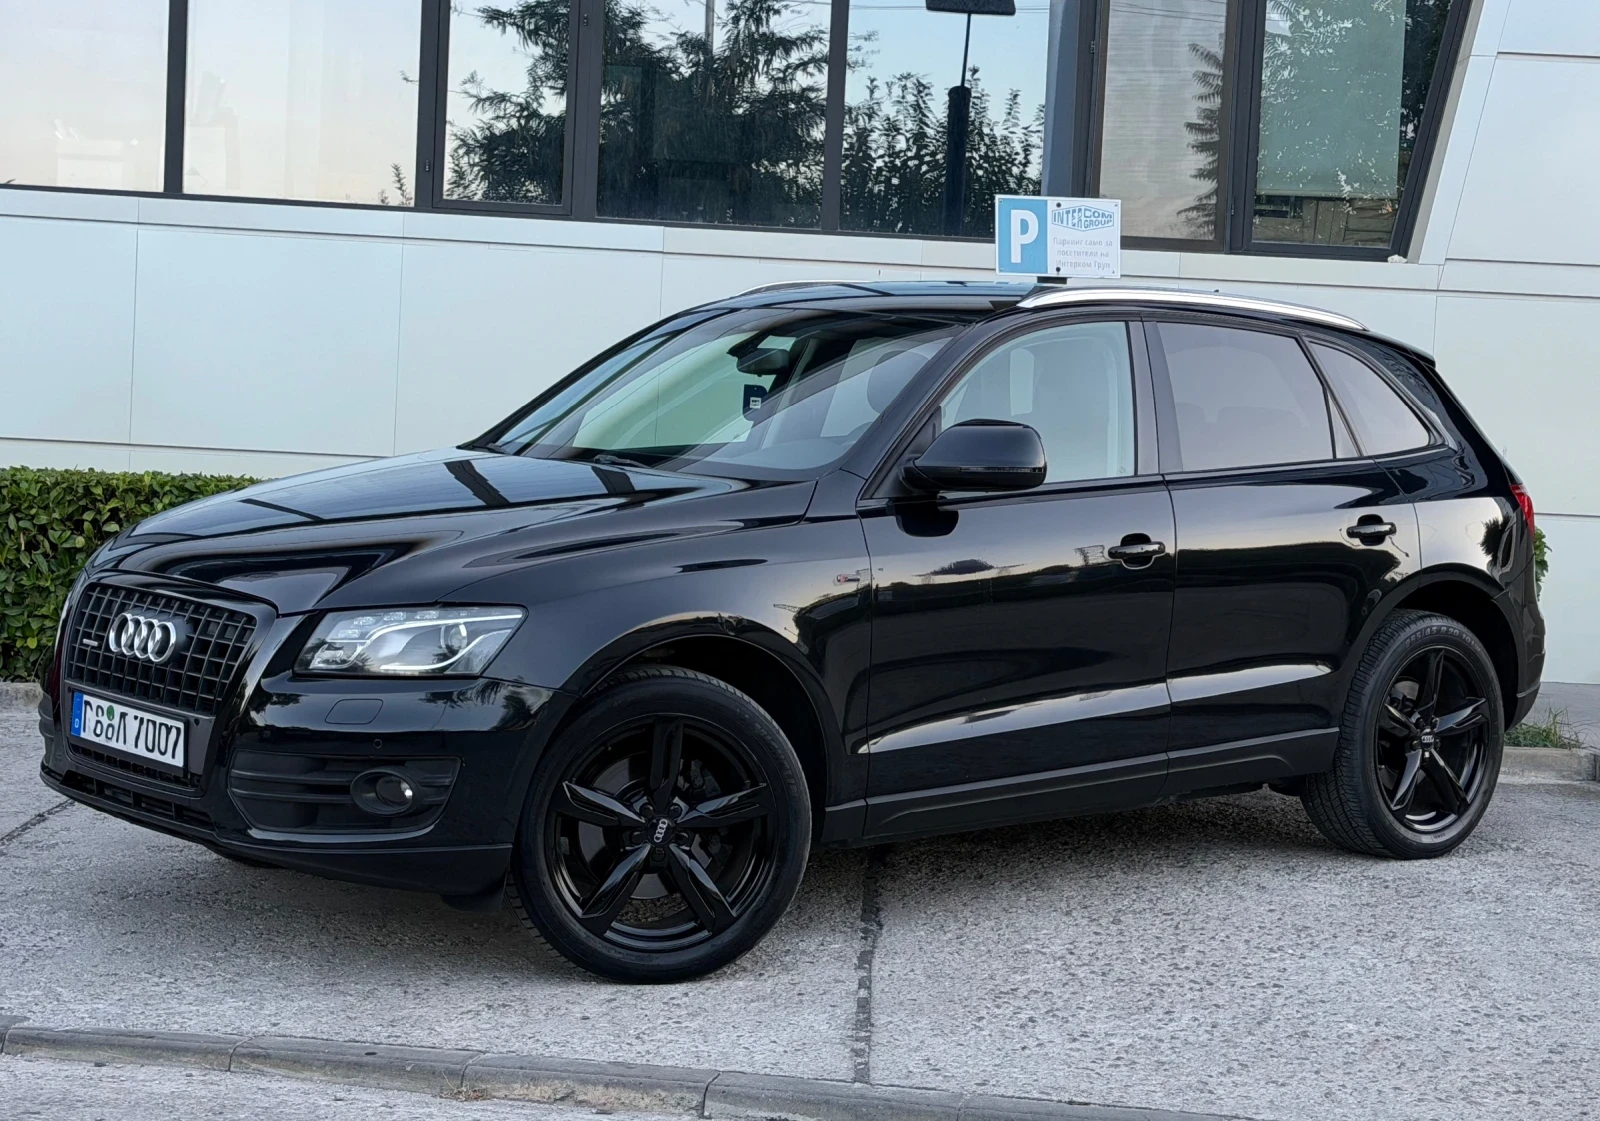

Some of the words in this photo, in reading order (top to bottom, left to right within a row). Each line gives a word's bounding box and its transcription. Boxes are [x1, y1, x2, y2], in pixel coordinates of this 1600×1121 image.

[1083, 219, 1113, 229] GROUP
[1010, 209, 1039, 264] P
[1053, 237, 1083, 247] Паркинг
[1094, 260, 1110, 270] Груп
